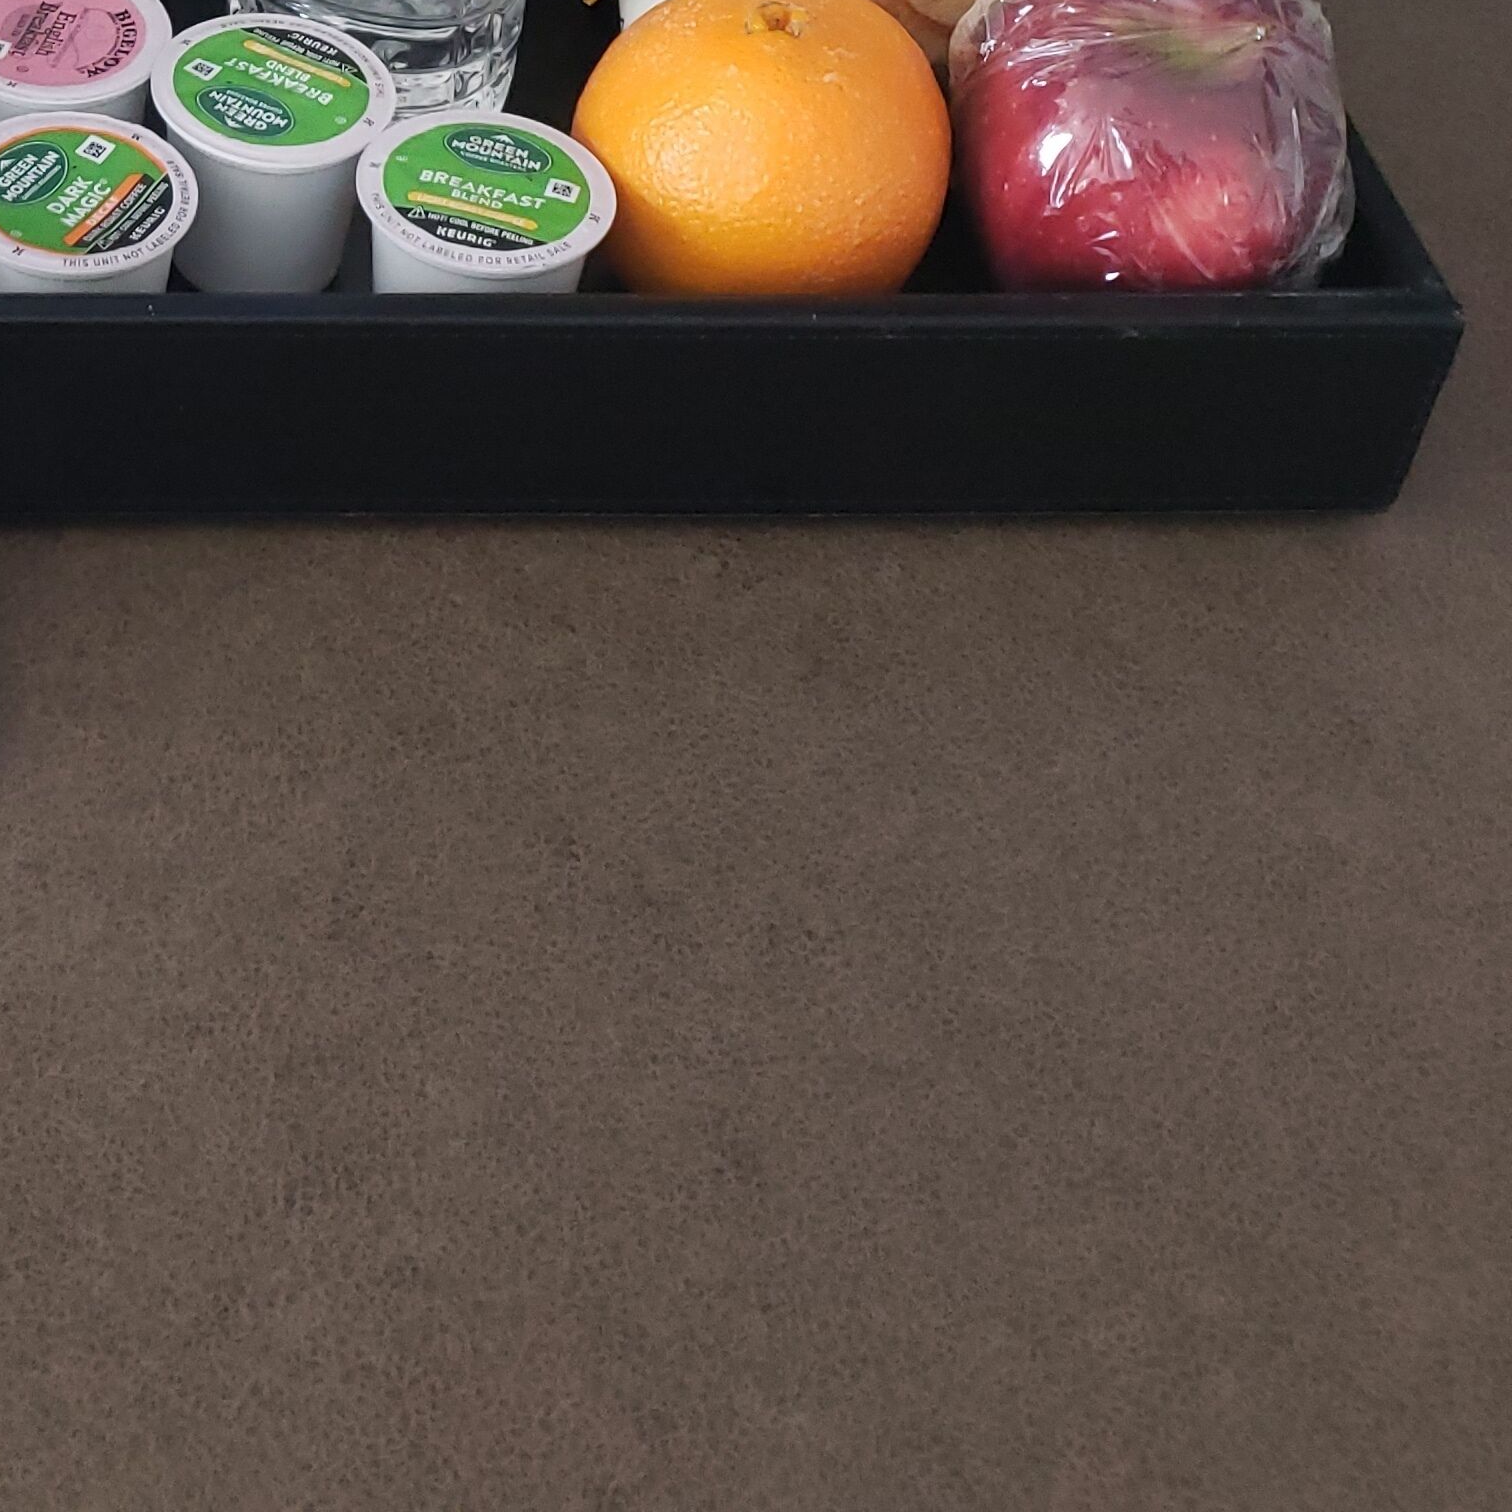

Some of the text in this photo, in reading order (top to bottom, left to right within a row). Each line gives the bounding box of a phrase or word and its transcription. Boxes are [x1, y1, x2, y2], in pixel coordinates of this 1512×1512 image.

[35, 10, 77, 57] English
[87, 8, 138, 79] BIGELOW
[290, 32, 338, 57] KEURIG
[224, 58, 334, 106] BREAKFAST
[266, 59, 312, 83] BLEND
[209, 90, 289, 129] MOUNTAIN
[214, 103, 268, 131] GREEN
[451, 139, 542, 172] MOUNTAIN
[469, 135, 530, 160] GREEN
[1, 150, 61, 202] MOUNTAIN
[46, 175, 93, 214] DARK
[419, 169, 547, 209] BREAKFAST
[60, 182, 111, 228] MAGIC
[450, 188, 504, 210] BLEND
[63, 258, 89, 267] THIS
[93, 255, 120, 266] UNIT
[123, 248, 144, 260] NOT
[145, 223, 181, 252] LABELED
[175, 206, 188, 222] FOR
[129, 205, 165, 240] KEURIG
[427, 212, 534, 246] HOT! COOL BEFORE PEELING
[436, 225, 493, 248] KEURIG
[401, 227, 421, 245] NOT
[421, 240, 473, 263] LABELED
[478, 255, 502, 266] FOR
[506, 251, 545, 266] RETAIL
[546, 240, 572, 258] SALE
